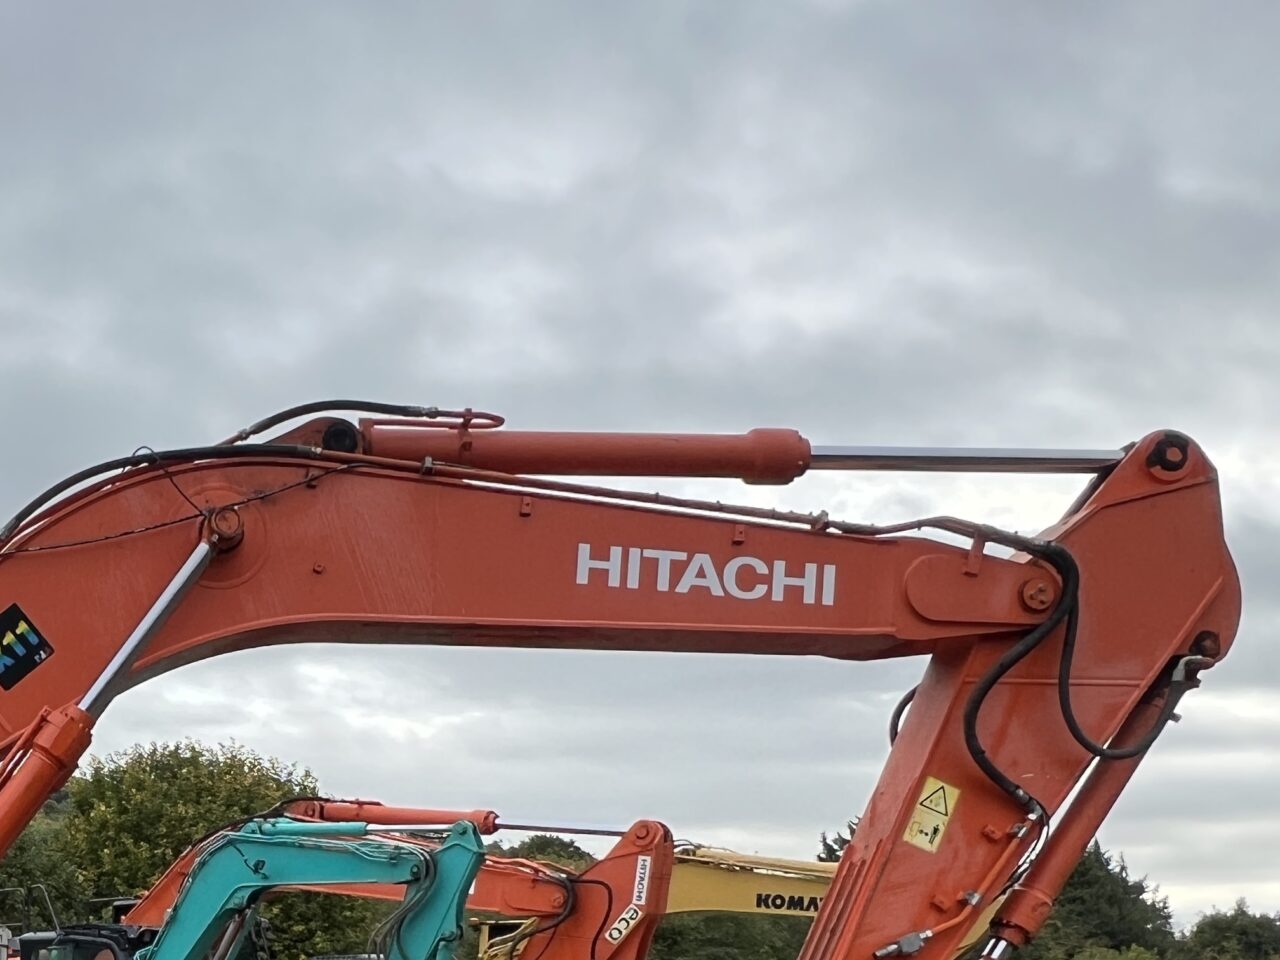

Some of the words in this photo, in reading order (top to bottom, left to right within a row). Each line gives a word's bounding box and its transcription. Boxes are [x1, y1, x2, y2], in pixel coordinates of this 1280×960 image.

[576, 543, 836, 606] HITACHI
[635, 858, 648, 902] HITACHI
[756, 893, 824, 912] KOMA
[608, 907, 640, 941] eco
